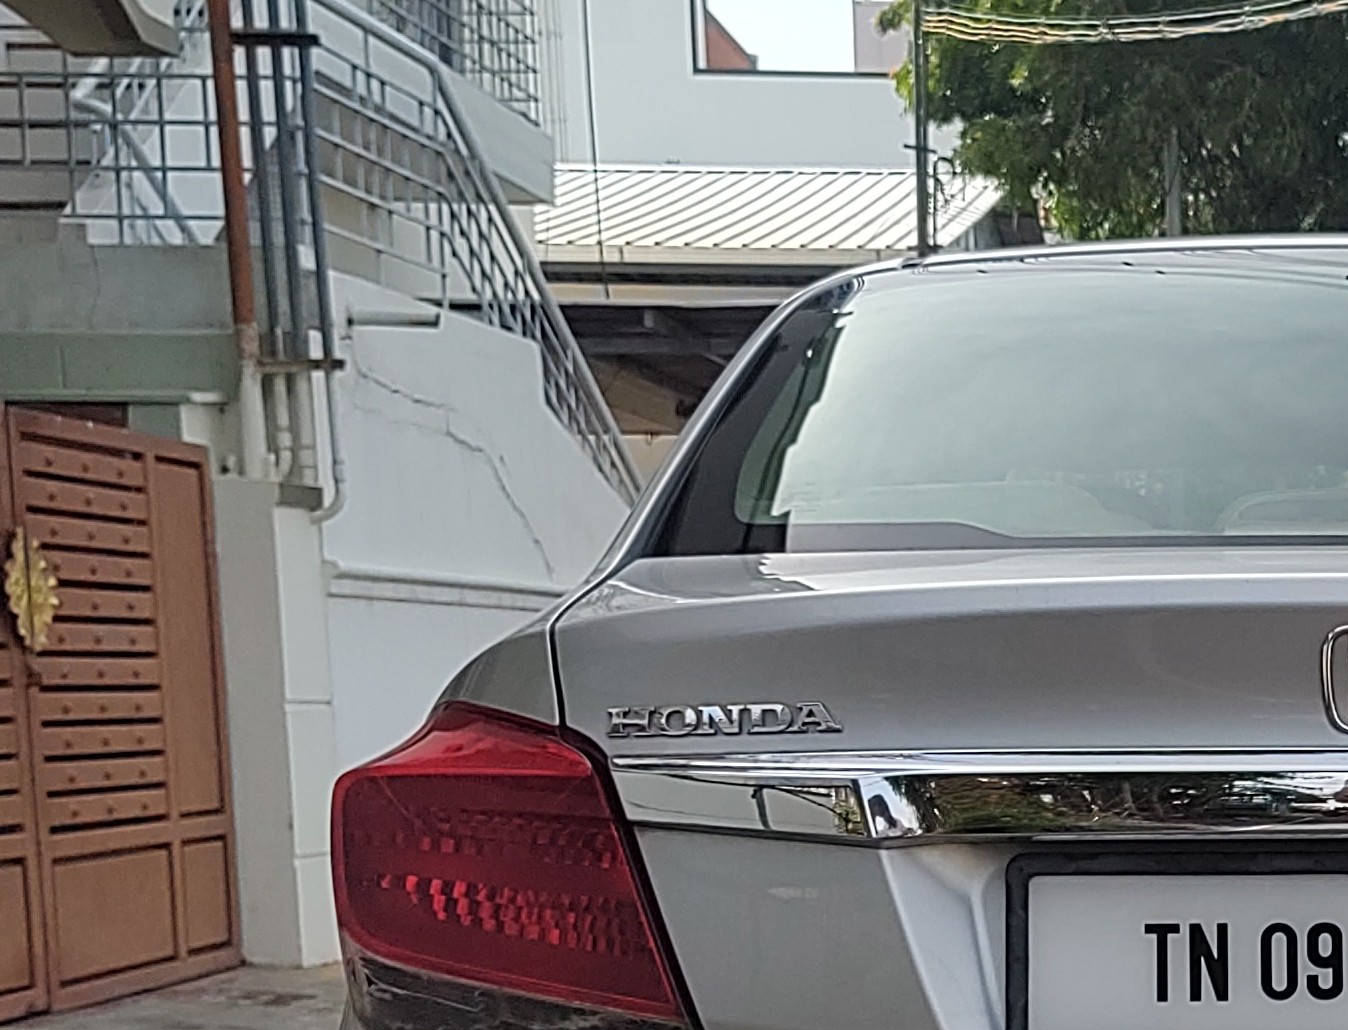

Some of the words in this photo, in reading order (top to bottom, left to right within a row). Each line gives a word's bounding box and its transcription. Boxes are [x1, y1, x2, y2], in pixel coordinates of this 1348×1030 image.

[606, 701, 843, 738] HONDA
[1144, 923, 1229, 1002] TN
[1260, 922, 1344, 1001] 09
